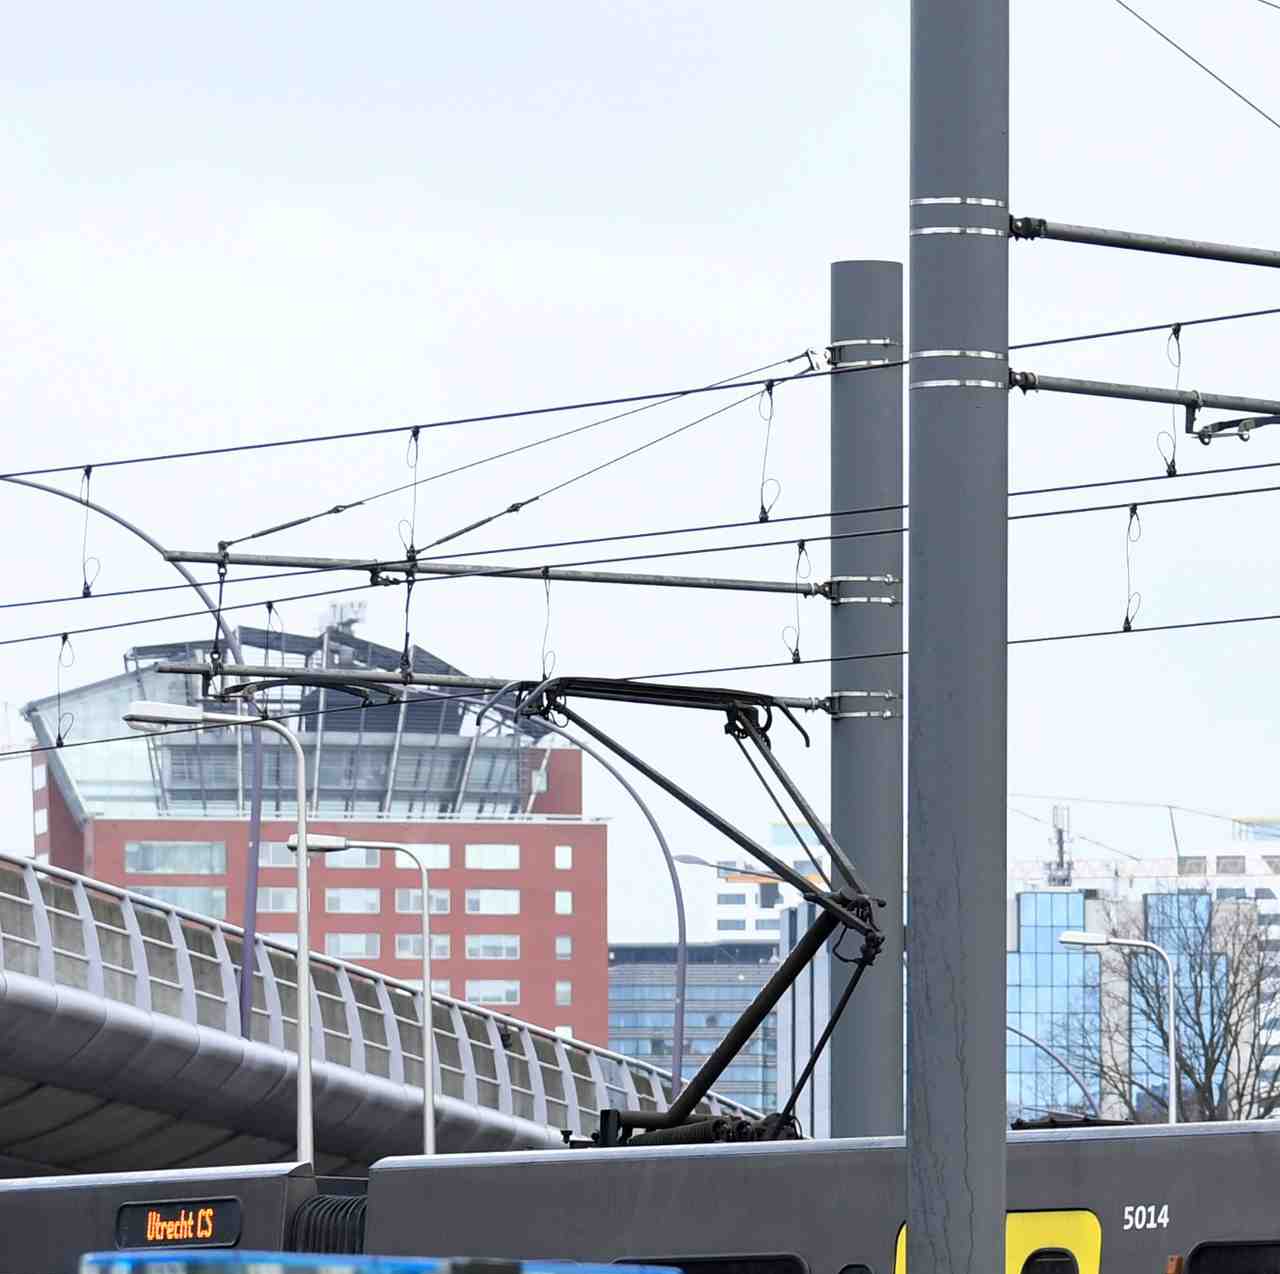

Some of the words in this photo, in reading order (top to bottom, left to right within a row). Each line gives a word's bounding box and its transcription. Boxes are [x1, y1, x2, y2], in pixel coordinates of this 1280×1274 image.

[147, 1209, 194, 1240] Utrecht
[197, 1208, 213, 1238] CS
[1123, 1204, 1170, 1230] 5014
